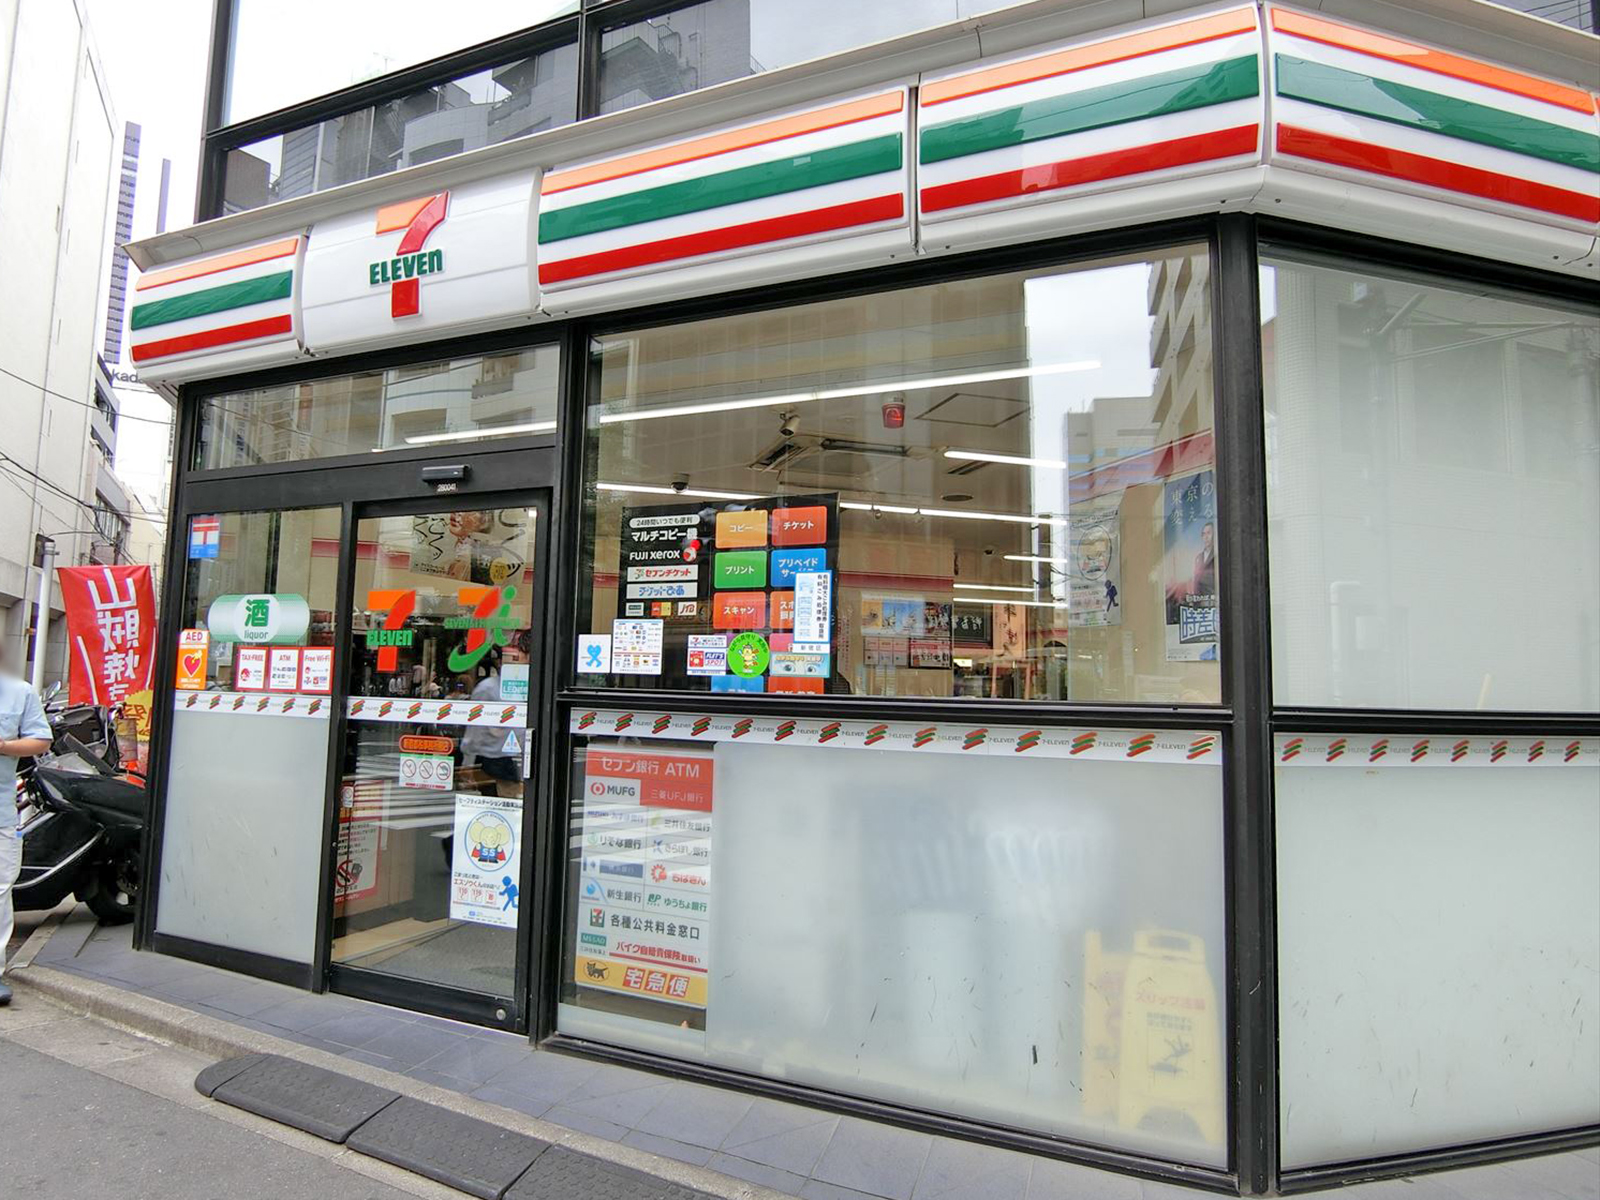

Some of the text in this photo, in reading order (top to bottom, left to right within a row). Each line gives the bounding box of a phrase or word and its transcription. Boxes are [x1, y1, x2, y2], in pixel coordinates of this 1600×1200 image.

[636, 516, 693, 527] 24時間いつでも便利
[783, 521, 814, 530] チケット
[729, 524, 754, 533] コピー
[629, 551, 648, 560] FUJI
[778, 558, 818, 568] プリペイド
[645, 568, 691, 578] セブンチケット
[725, 565, 755, 575] プリント
[244, 599, 270, 627] 酒
[680, 604, 695, 614] JTB
[723, 606, 755, 615] スキャン
[185, 631, 203, 642] AED
[244, 629, 269, 641] liquor
[279, 654, 291, 662] ATM
[602, 756, 700, 778] セブン銀行 ATM
[607, 784, 636, 797] MUFG
[651, 788, 705, 804] 三菱UFJ銀行
[664, 818, 711, 833] 三井住友銀行
[599, 835, 642, 850] りそな銀行
[607, 889, 642, 903] 新生銀行
[664, 898, 707, 913] ゆうちょ銀行
[610, 914, 700, 940] 各種公共料金窓口
[624, 967, 690, 998] 宅急便
